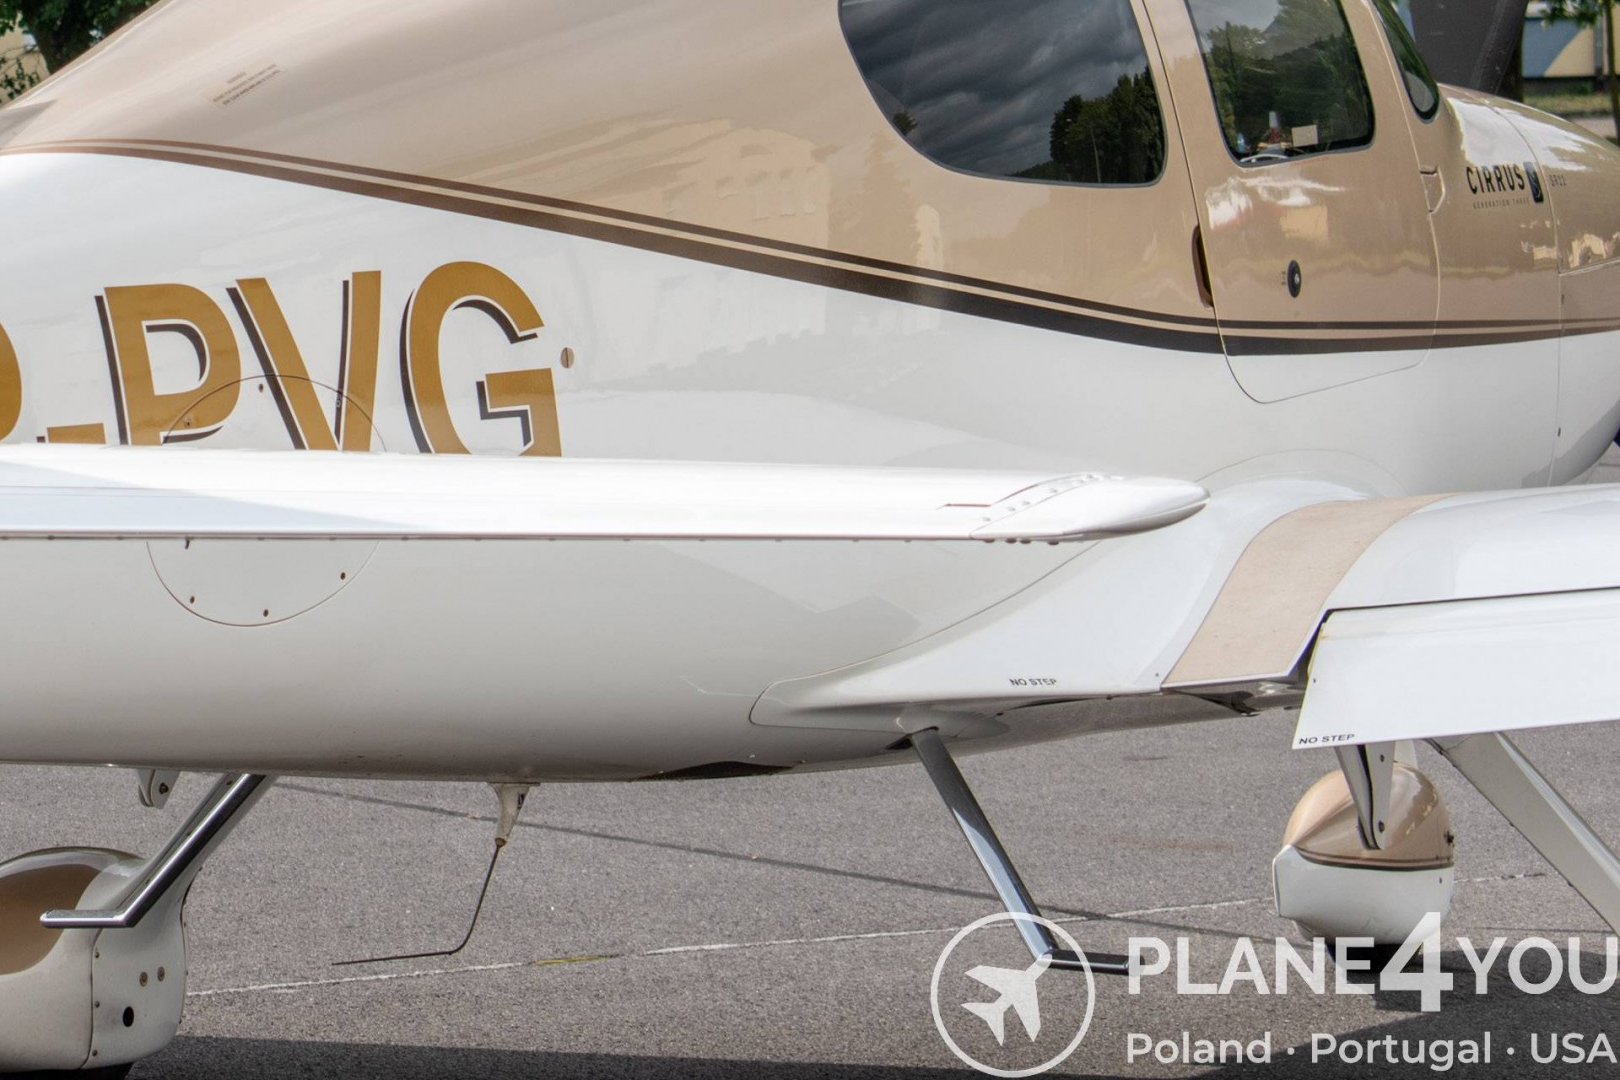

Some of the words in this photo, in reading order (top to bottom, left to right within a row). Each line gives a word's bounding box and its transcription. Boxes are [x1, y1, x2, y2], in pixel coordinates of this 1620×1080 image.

[1466, 164, 1525, 194] CIRRUS
[1009, 678, 1027, 686] NO
[1028, 678, 1057, 686] STEP
[1299, 736, 1318, 744] NO
[1321, 733, 1355, 743] STEP
